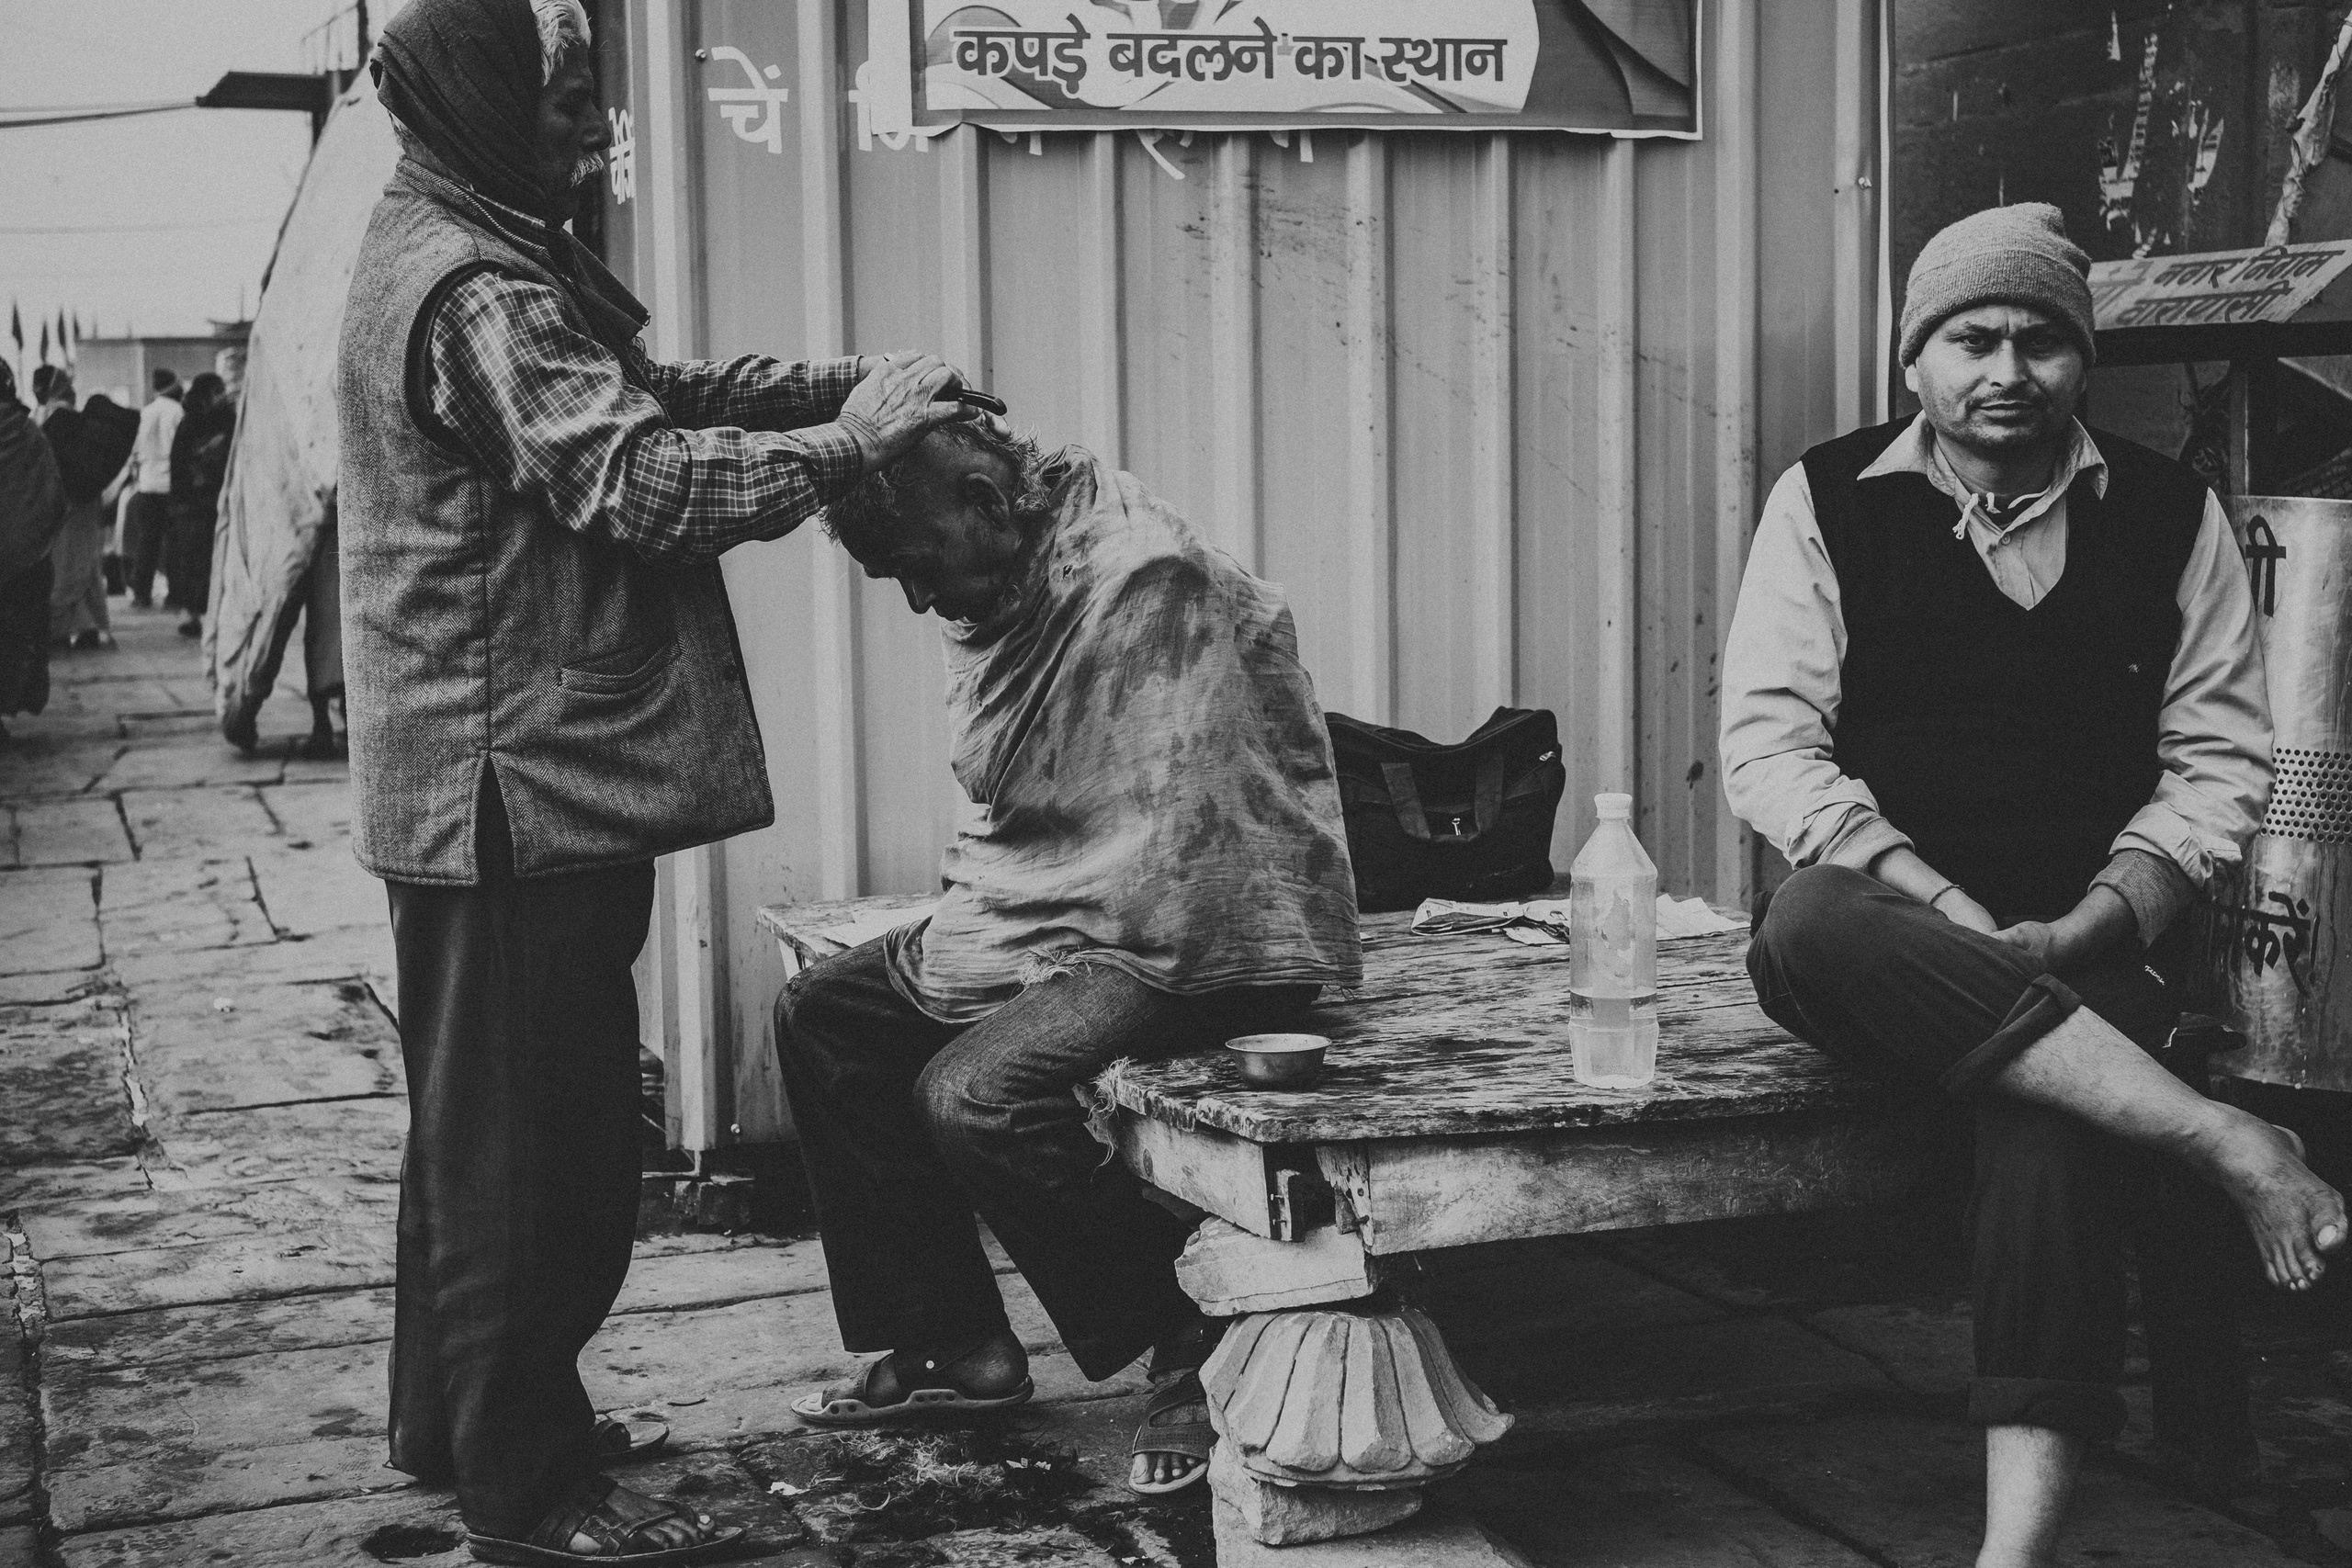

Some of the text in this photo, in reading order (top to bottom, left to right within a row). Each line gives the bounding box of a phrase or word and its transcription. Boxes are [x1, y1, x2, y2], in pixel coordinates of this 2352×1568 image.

[953, 14, 1508, 96] कपड़े बदलने का स्थान
